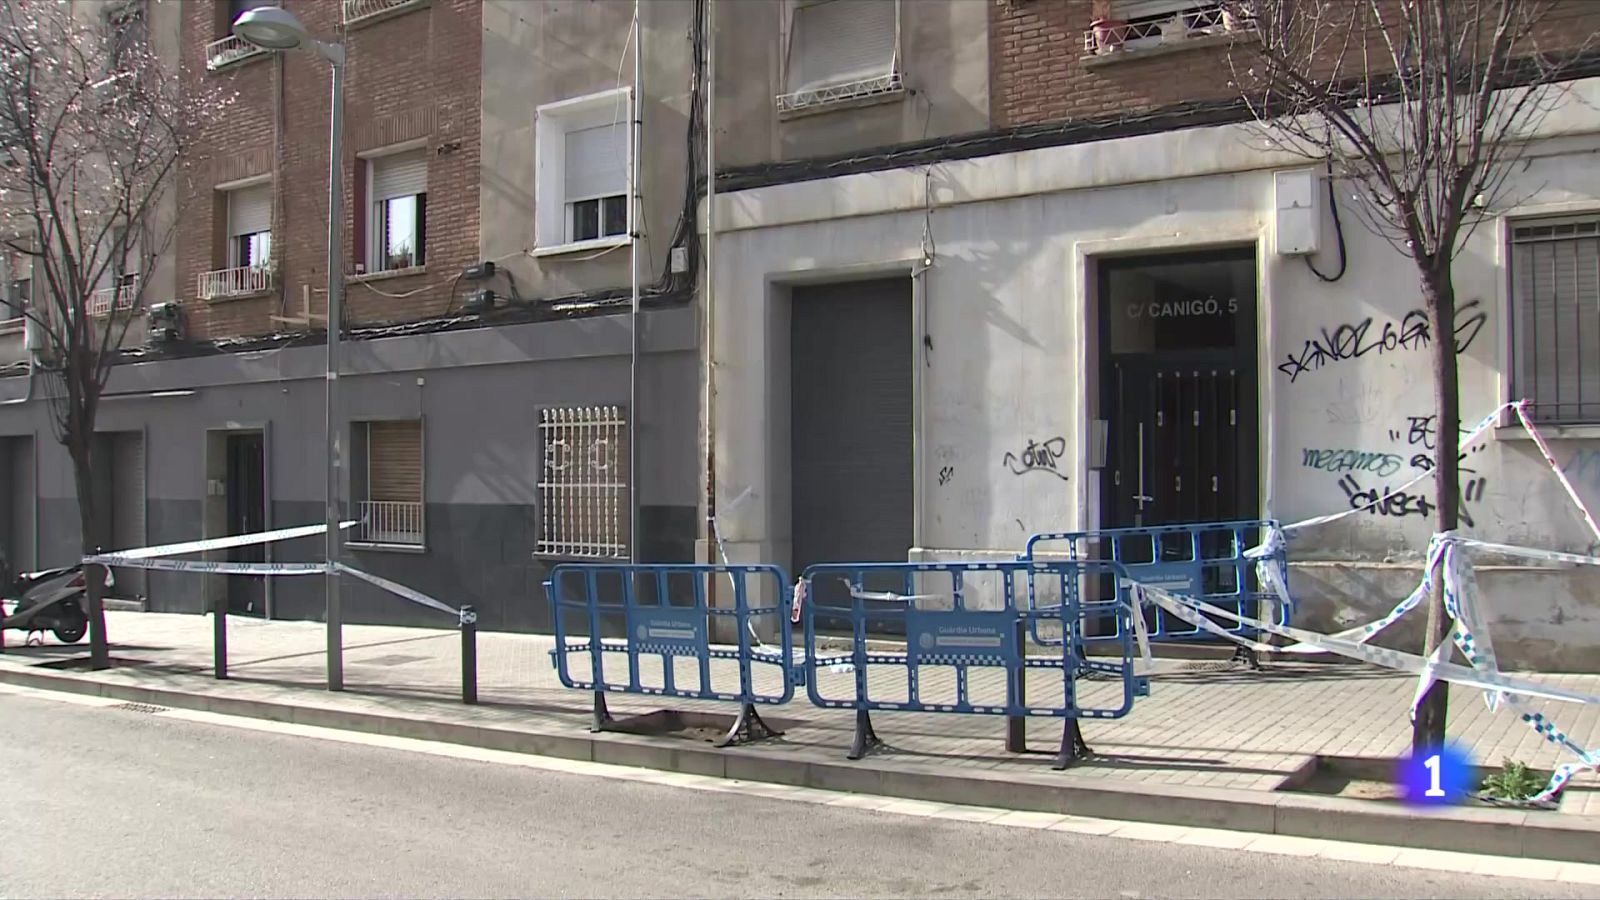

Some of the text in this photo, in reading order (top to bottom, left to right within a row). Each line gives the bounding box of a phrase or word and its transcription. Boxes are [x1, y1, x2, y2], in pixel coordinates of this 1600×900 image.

[1127, 296, 1238, 318] C/ CANIGÓ, 5
